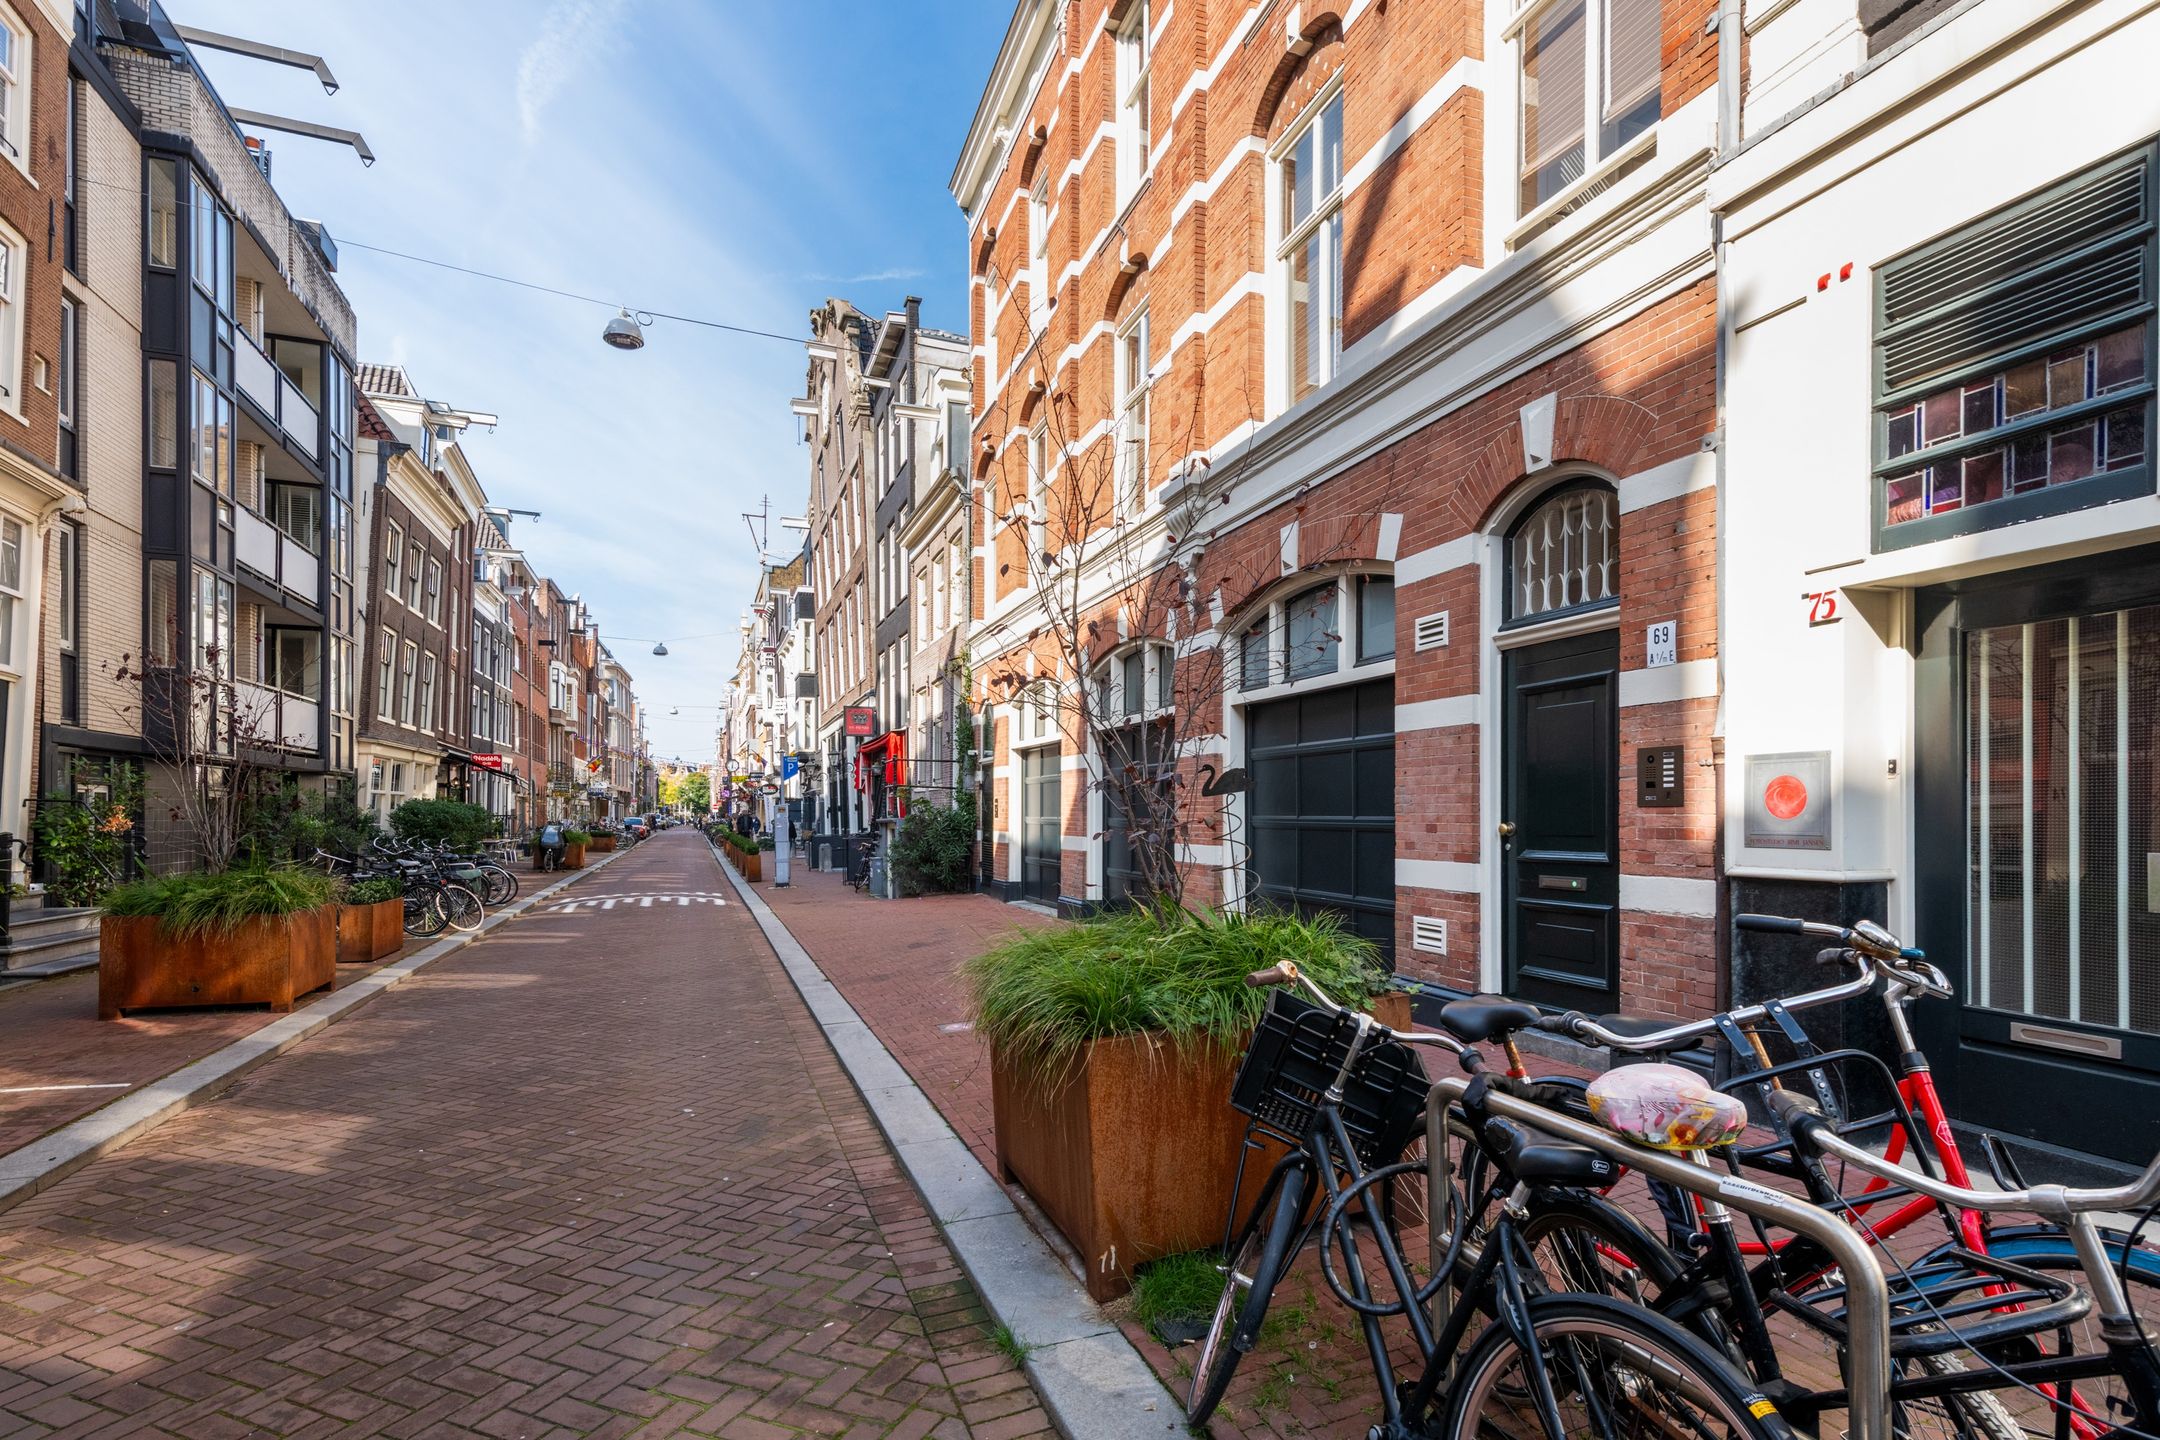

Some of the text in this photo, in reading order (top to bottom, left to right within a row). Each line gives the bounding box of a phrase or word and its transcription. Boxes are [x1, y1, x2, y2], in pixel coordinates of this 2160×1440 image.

[1809, 590, 1836, 622] 75
[1654, 626, 1669, 645] 69
[788, 763, 794, 772] P
